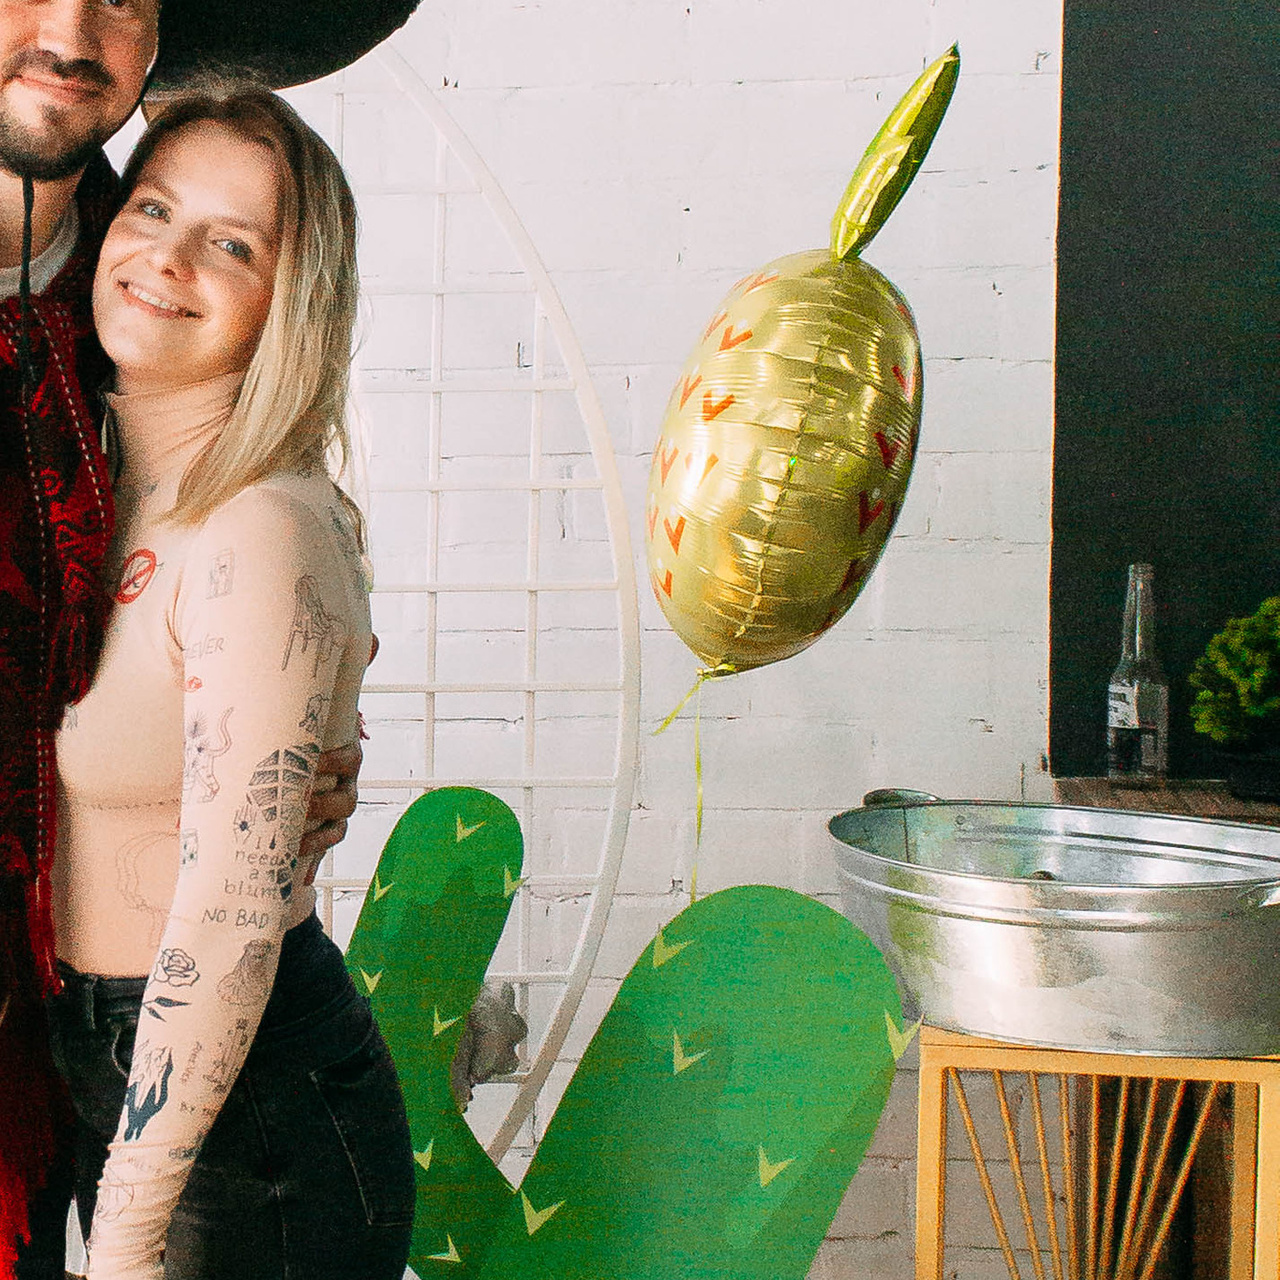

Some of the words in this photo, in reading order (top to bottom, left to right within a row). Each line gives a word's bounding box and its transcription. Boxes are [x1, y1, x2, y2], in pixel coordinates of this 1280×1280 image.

[186, 633, 224, 659] EVER
[202, 908, 227, 923] NO
[235, 908, 269, 929] BAD
